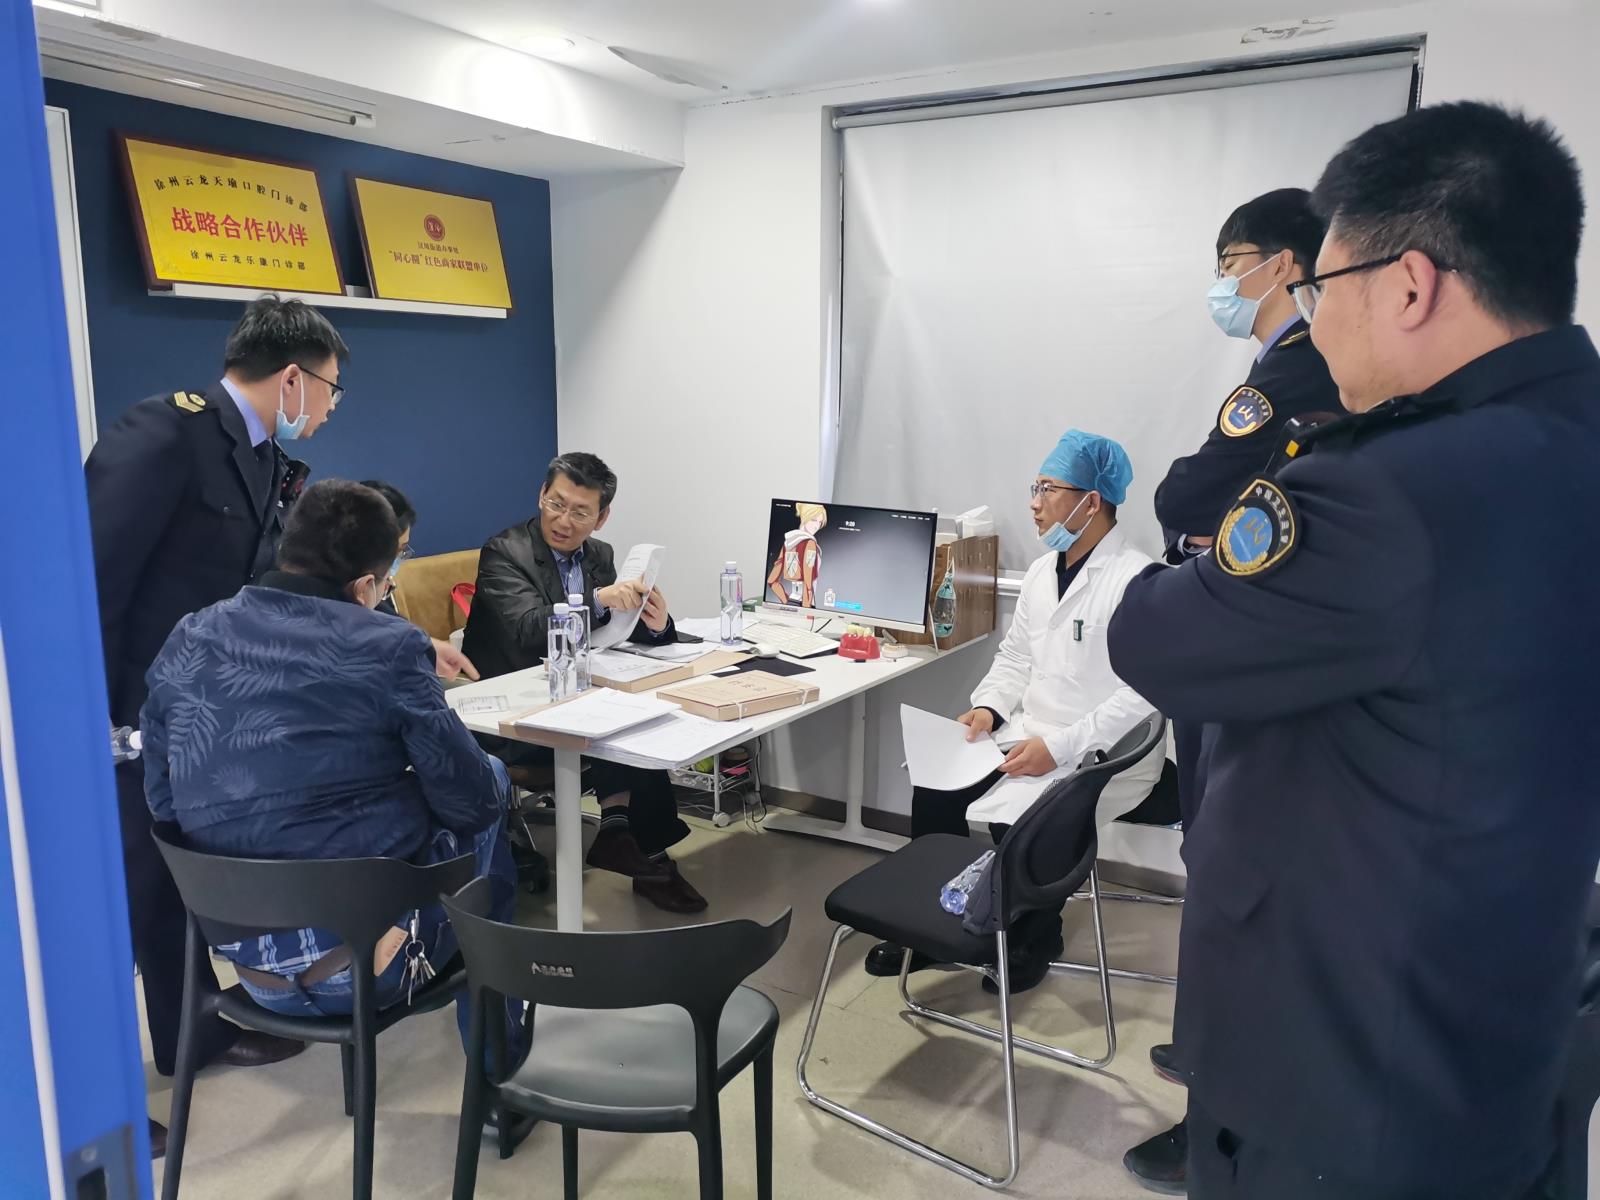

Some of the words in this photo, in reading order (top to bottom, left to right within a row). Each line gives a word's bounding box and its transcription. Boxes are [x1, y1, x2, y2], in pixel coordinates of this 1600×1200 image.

[171, 206, 309, 247] 战略合作伙伴
